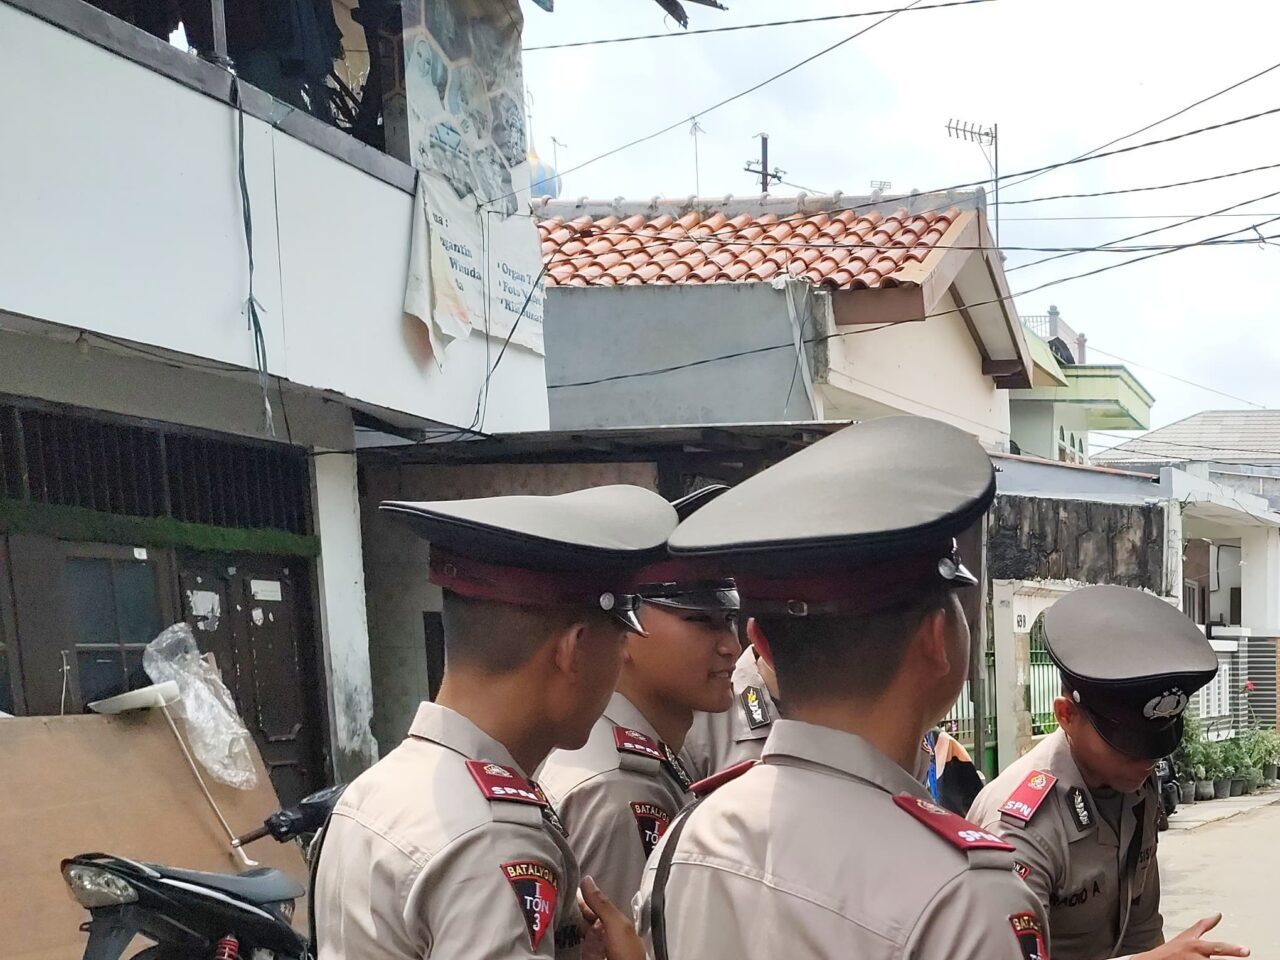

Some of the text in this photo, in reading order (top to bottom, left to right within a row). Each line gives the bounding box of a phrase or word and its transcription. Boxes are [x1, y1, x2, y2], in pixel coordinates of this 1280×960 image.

[491, 785, 538, 801] SPN
[1004, 800, 1032, 817] SPN
[645, 830, 662, 844] TO
[957, 829, 1003, 844] SPN
[524, 895, 550, 914] TON
[532, 913, 541, 932] 3
